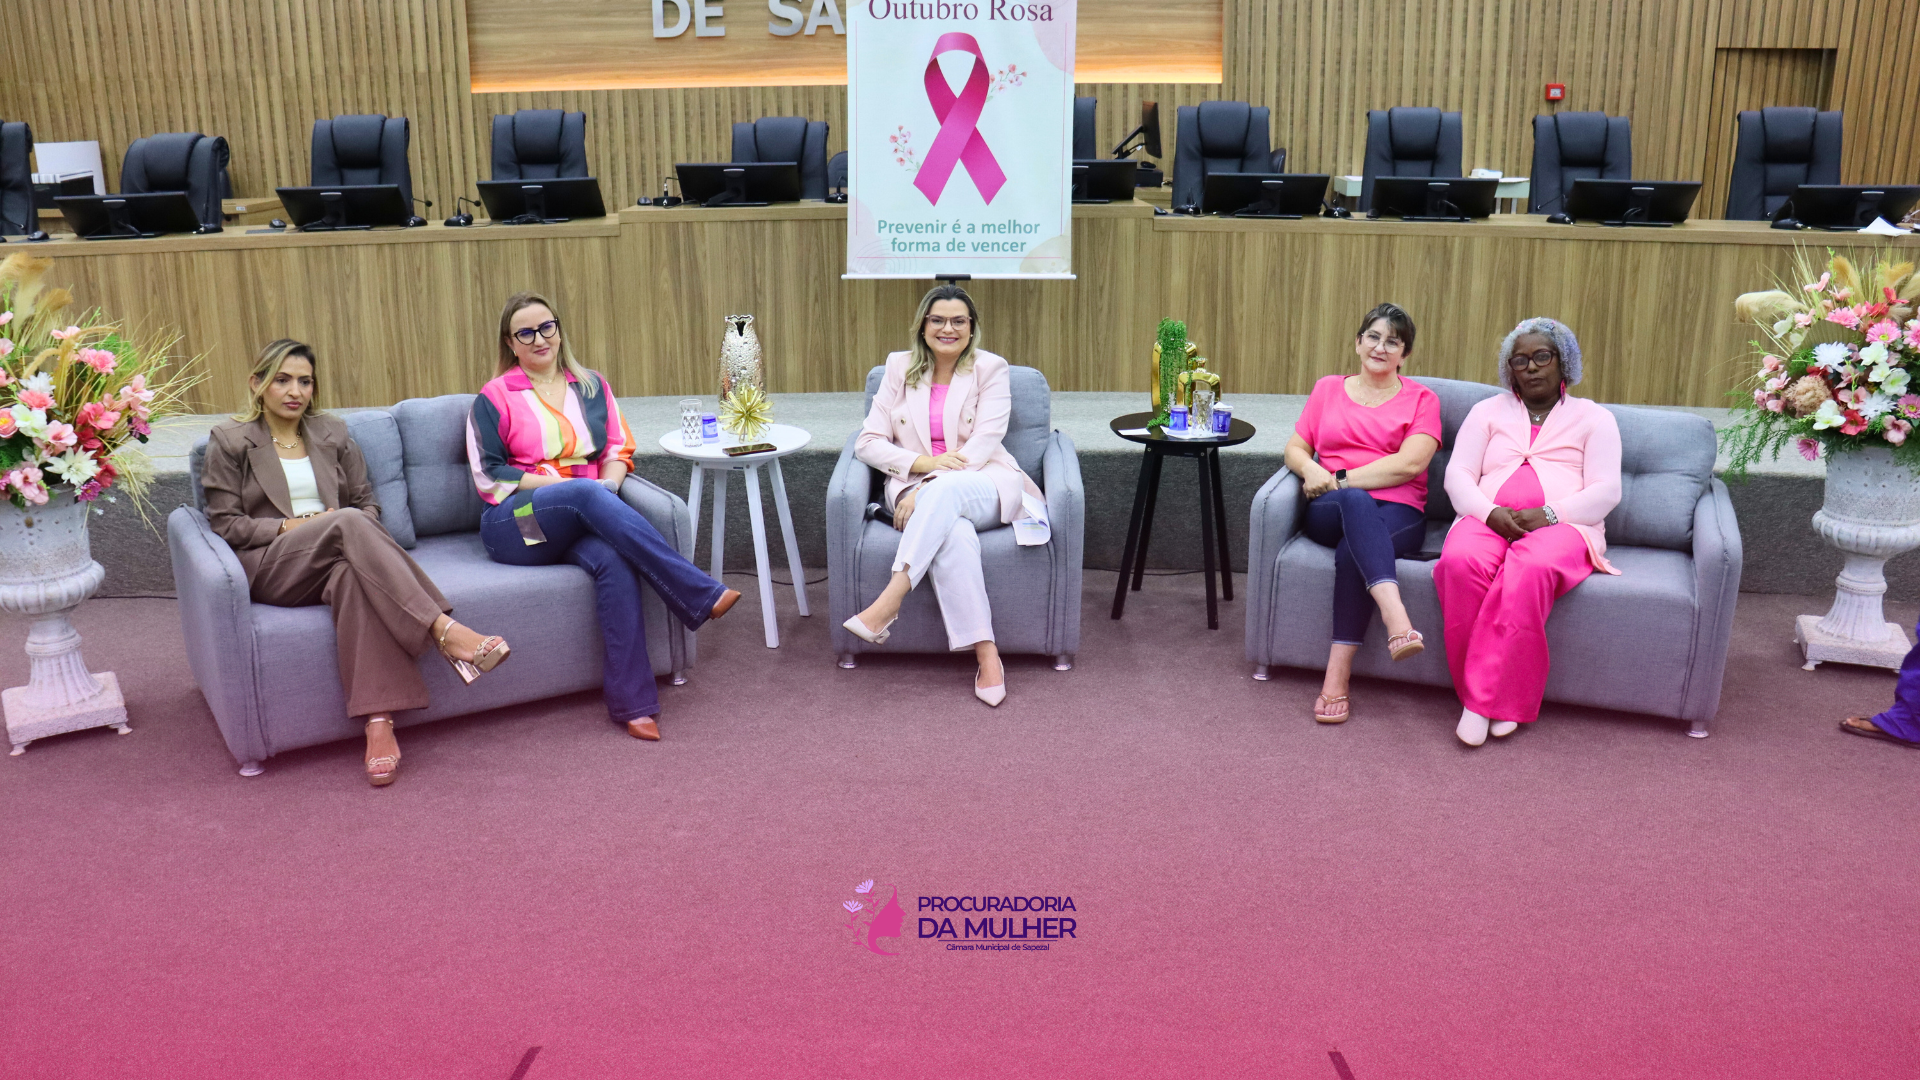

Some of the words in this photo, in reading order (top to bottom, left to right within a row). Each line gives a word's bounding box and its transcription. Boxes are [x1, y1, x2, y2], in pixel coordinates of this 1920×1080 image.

[652, 0, 726, 38] DE
[868, 0, 979, 20] Outubro
[988, 0, 1054, 21] Rosa
[877, 219, 947, 234] Prevenir
[951, 219, 962, 234] é
[966, 222, 976, 234] a
[981, 219, 1041, 234] melhor
[891, 237, 941, 252] forma
[945, 237, 966, 252] de
[971, 240, 1027, 252] vencer
